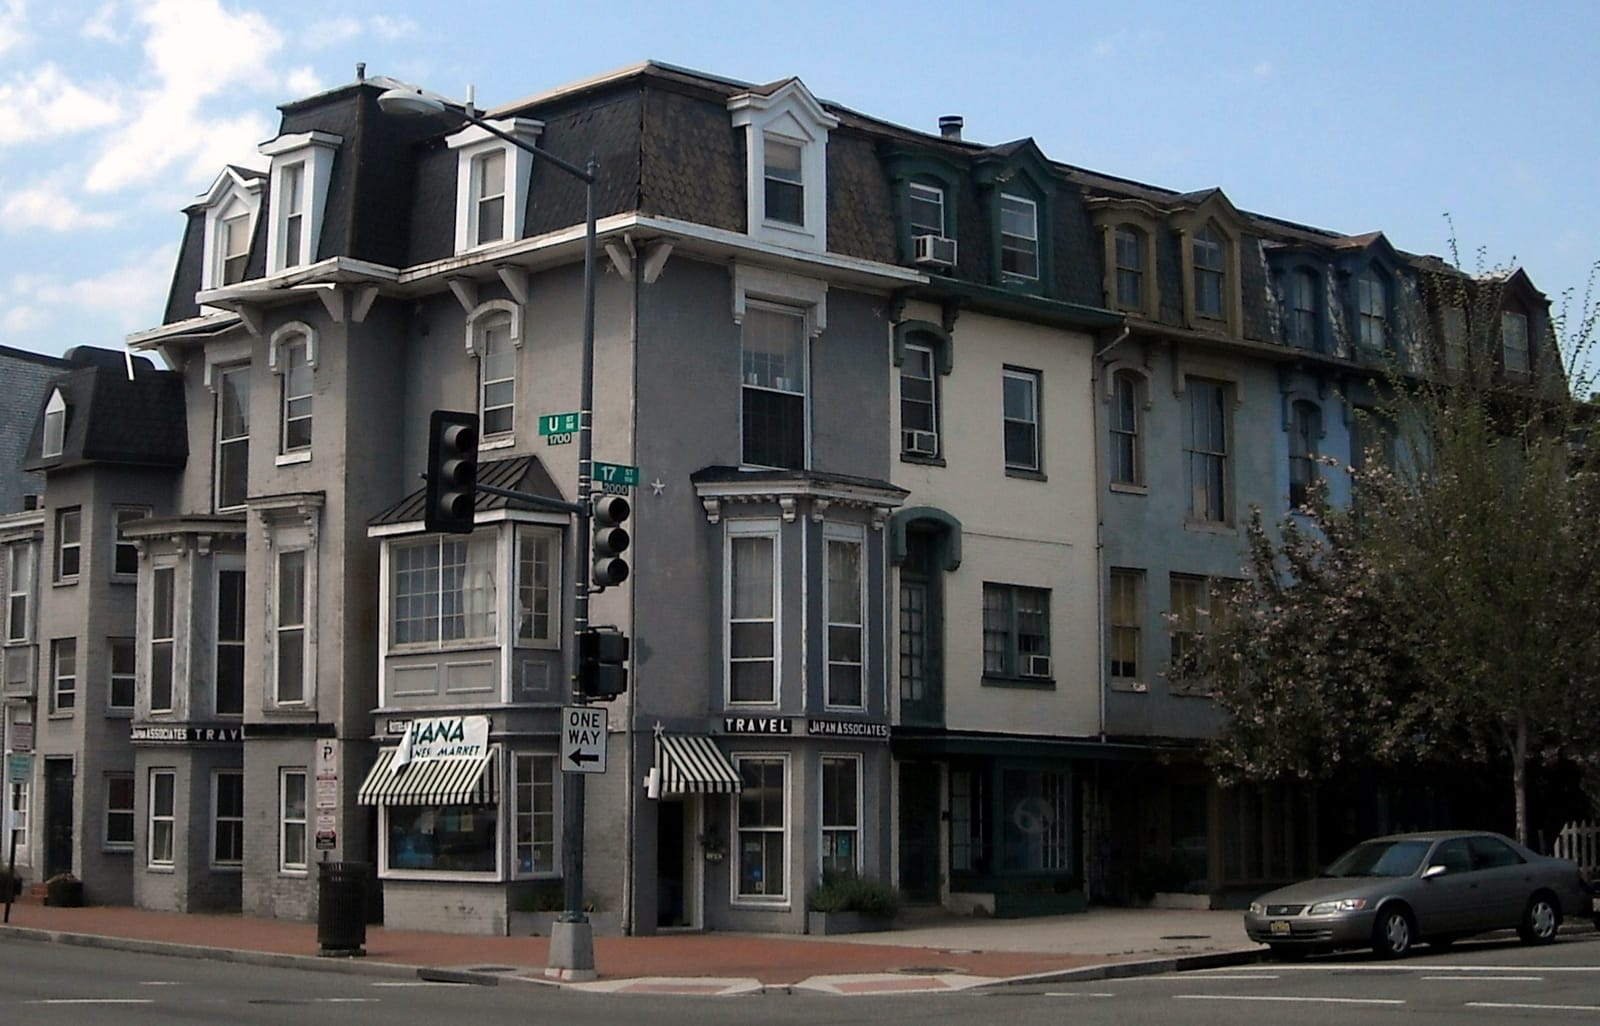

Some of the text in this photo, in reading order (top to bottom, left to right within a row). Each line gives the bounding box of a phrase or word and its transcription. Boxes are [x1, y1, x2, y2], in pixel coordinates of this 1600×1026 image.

[548, 416, 559, 432] U
[549, 432, 571, 444] 1700
[601, 465, 617, 481] 17
[604, 483, 628, 495] 2000
[570, 711, 600, 728] ONE
[725, 718, 788, 732] TRAVEL
[411, 719, 465, 745] HANA
[568, 729, 600, 745] WAY
[437, 745, 481, 757] MARKET
